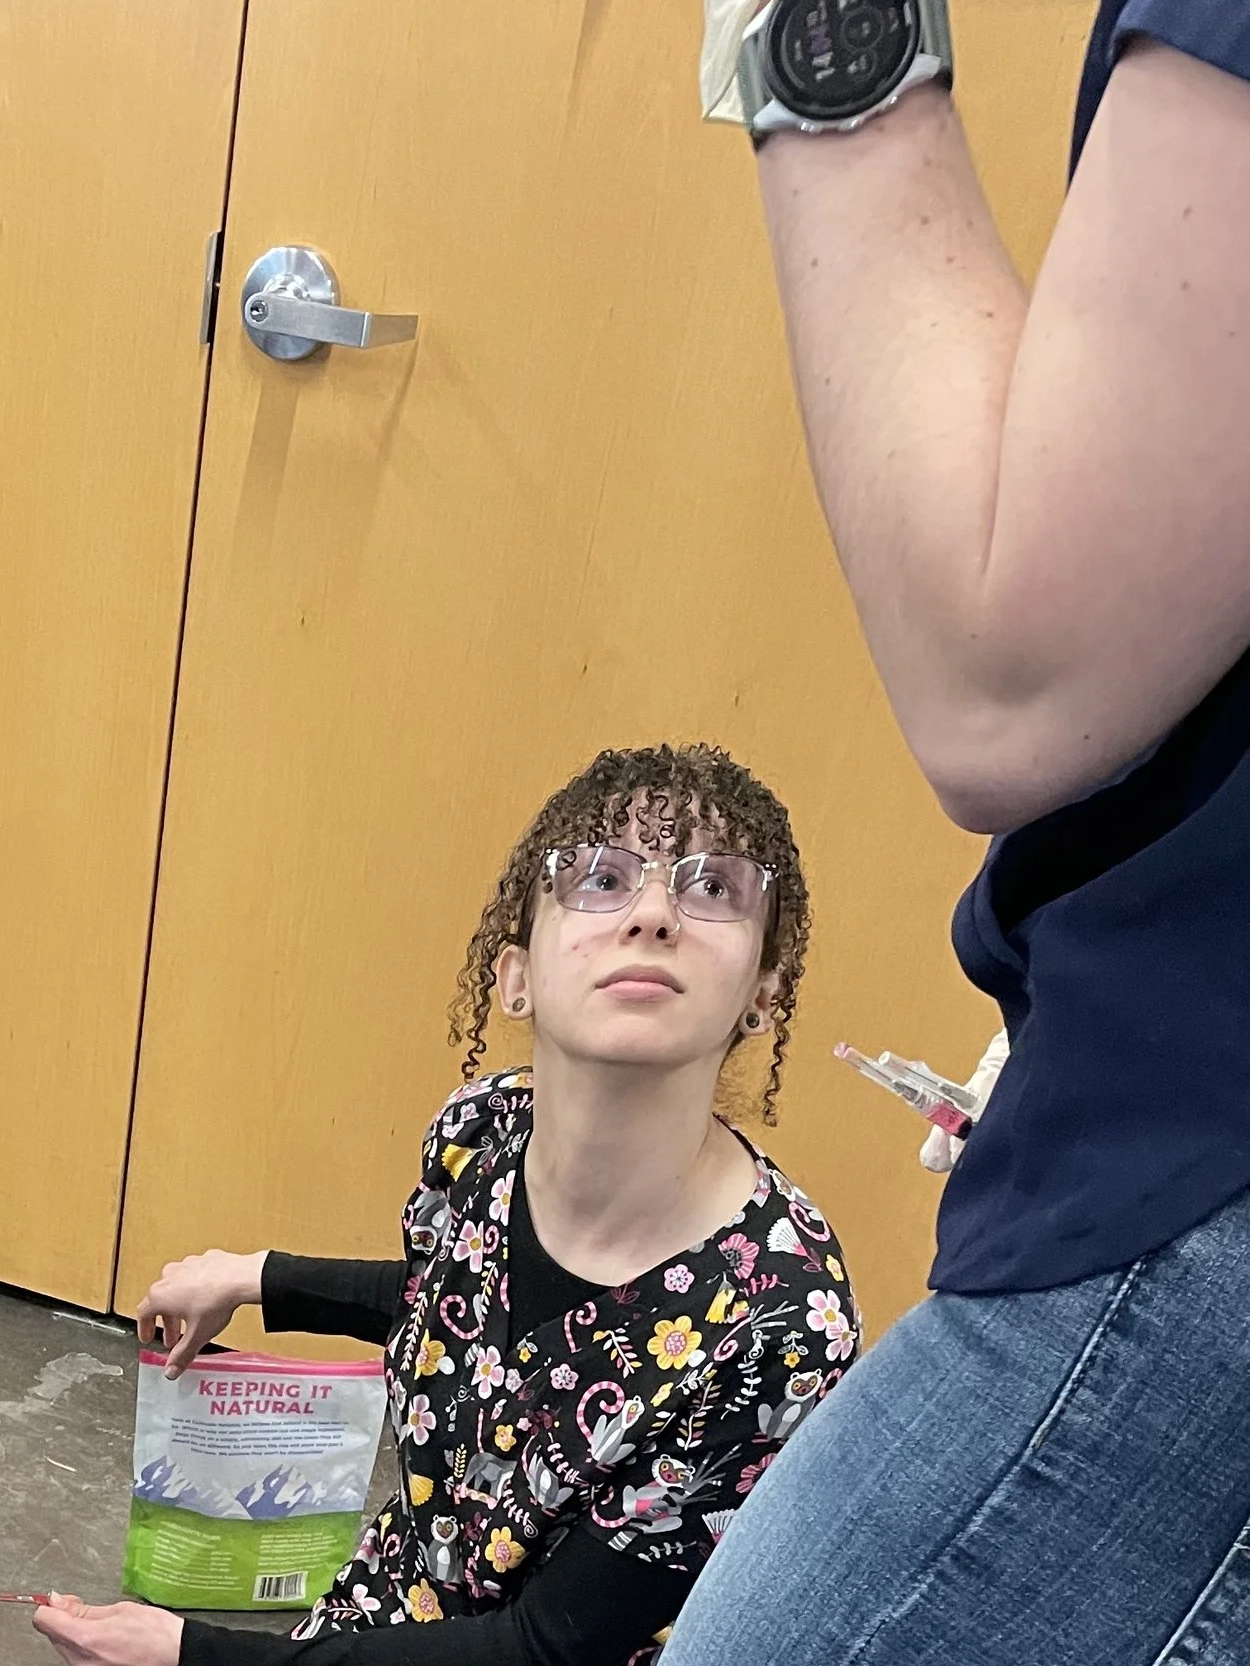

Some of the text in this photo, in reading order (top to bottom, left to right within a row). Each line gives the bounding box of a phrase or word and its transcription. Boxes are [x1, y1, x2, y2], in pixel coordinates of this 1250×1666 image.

[198, 1379, 333, 1400] KEEPING IT
[209, 1399, 315, 1416] NATURAL
